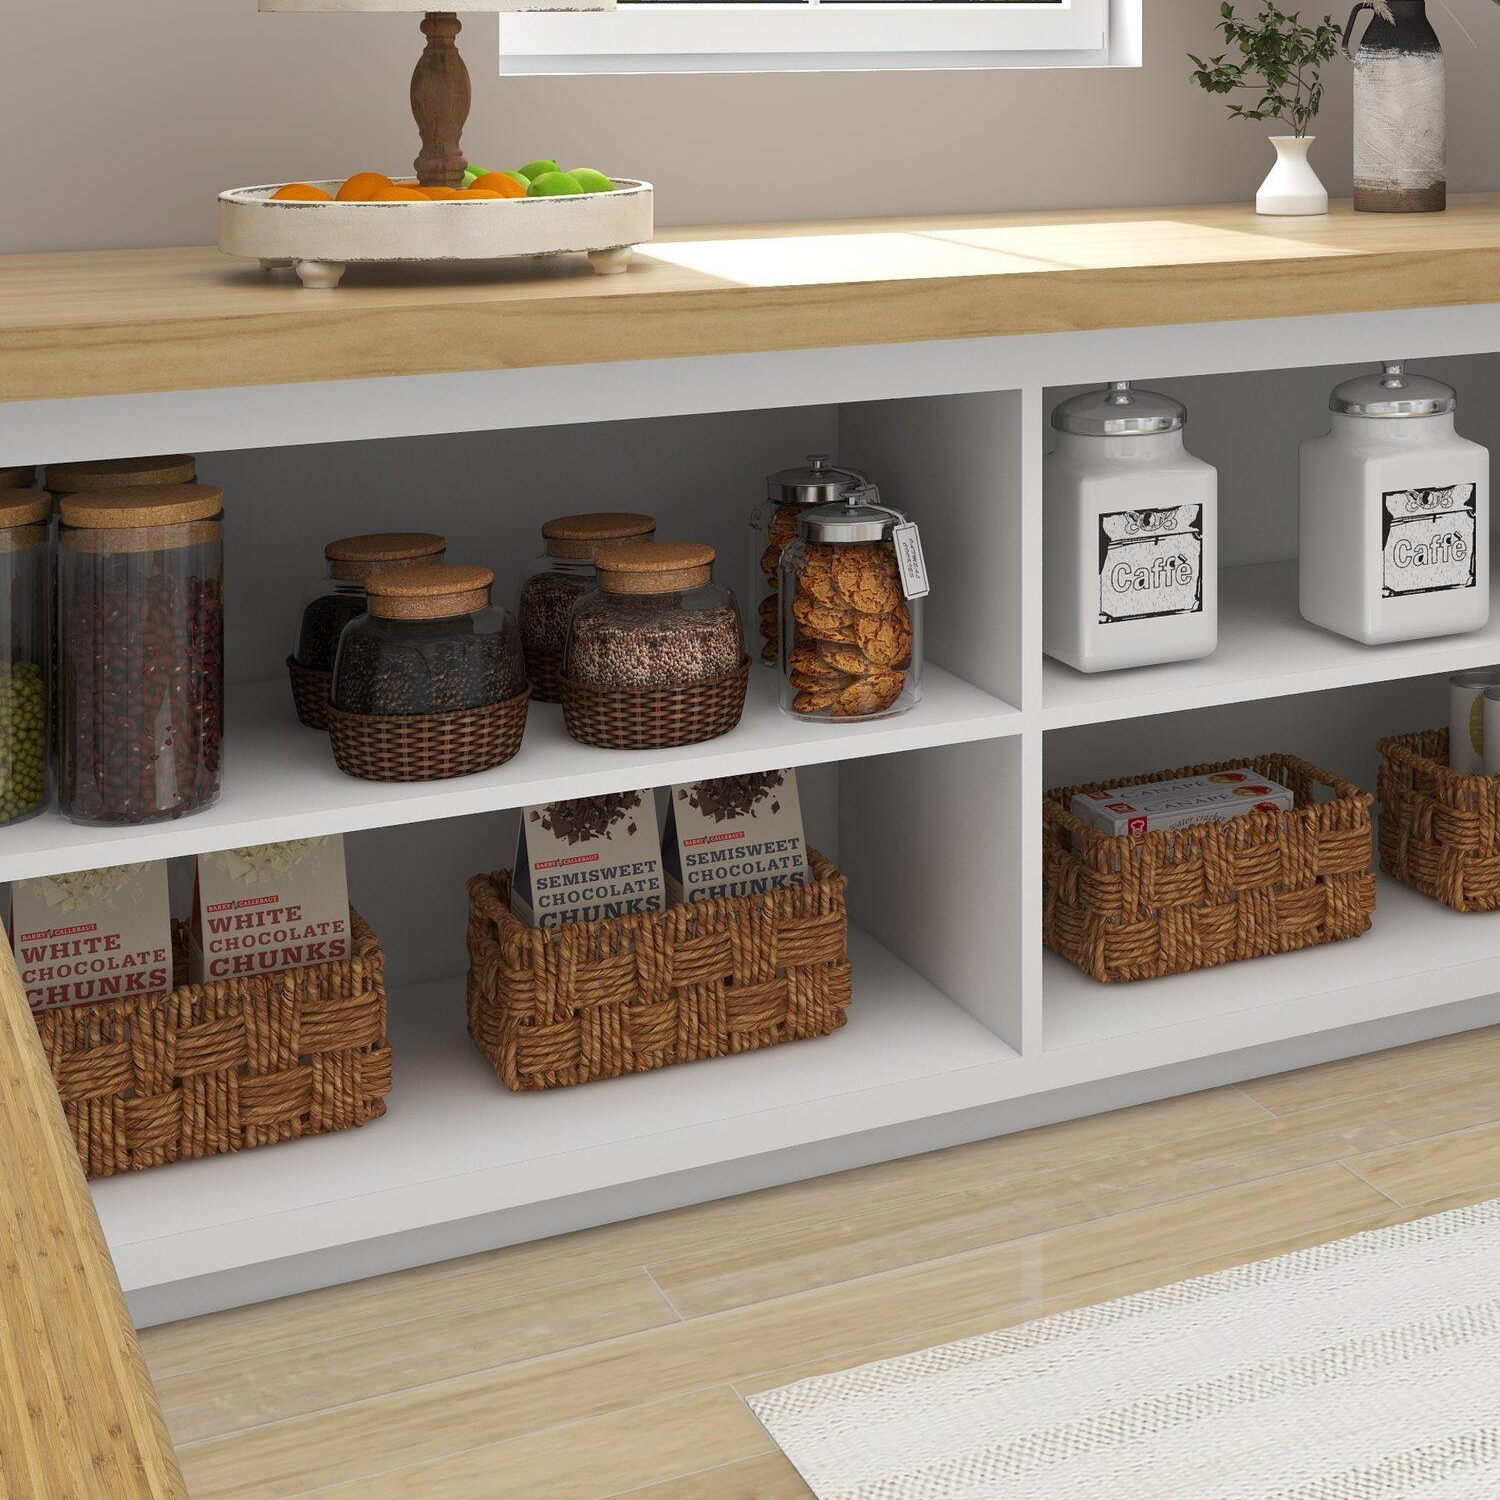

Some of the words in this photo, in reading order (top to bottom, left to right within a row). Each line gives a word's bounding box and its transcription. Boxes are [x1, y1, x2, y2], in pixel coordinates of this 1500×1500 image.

[1393, 531, 1467, 568] Caffè
[1111, 553, 1193, 593] Caffè
[686, 838, 800, 867] SEMISWEET
[537, 860, 657, 890] SEMISWEET
[688, 855, 803, 884] CHOCOLATE
[538, 878, 660, 908] CHOCOLATE
[689, 872, 804, 903] CHUNKS
[208, 903, 232, 912] BARRY
[208, 905, 301, 934] WHITE
[539, 895, 661, 929] CHUNKS
[21, 934, 121, 964] WHITE
[22, 932, 47, 940] BARRY
[209, 920, 345, 953] CHOCOLATE
[22, 948, 166, 983] CHOCOLATE
[209, 938, 346, 977] CHUNKS
[26, 968, 167, 1008] CHUNKS
